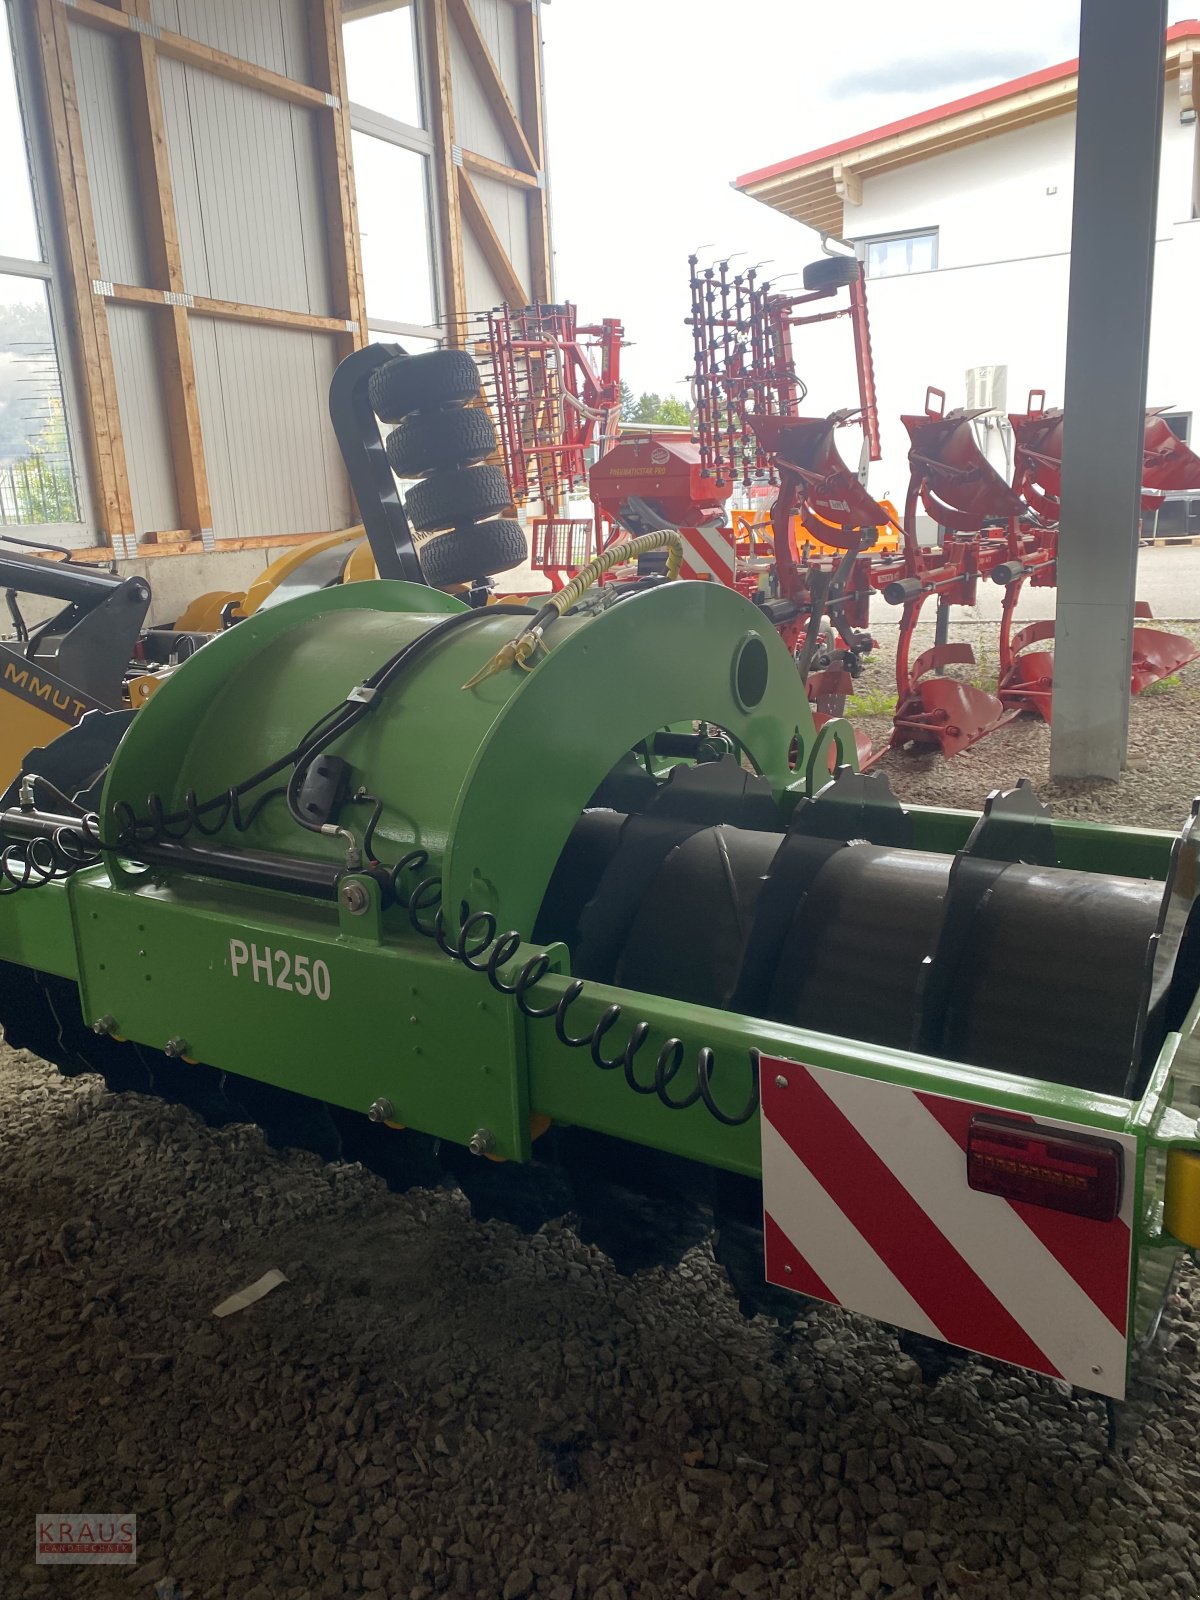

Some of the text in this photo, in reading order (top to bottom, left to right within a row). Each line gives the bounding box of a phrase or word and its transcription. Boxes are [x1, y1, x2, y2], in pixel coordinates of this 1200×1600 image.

[654, 467, 666, 476] PRO
[4, 662, 87, 717] MMUT
[229, 938, 331, 1001] PH250
